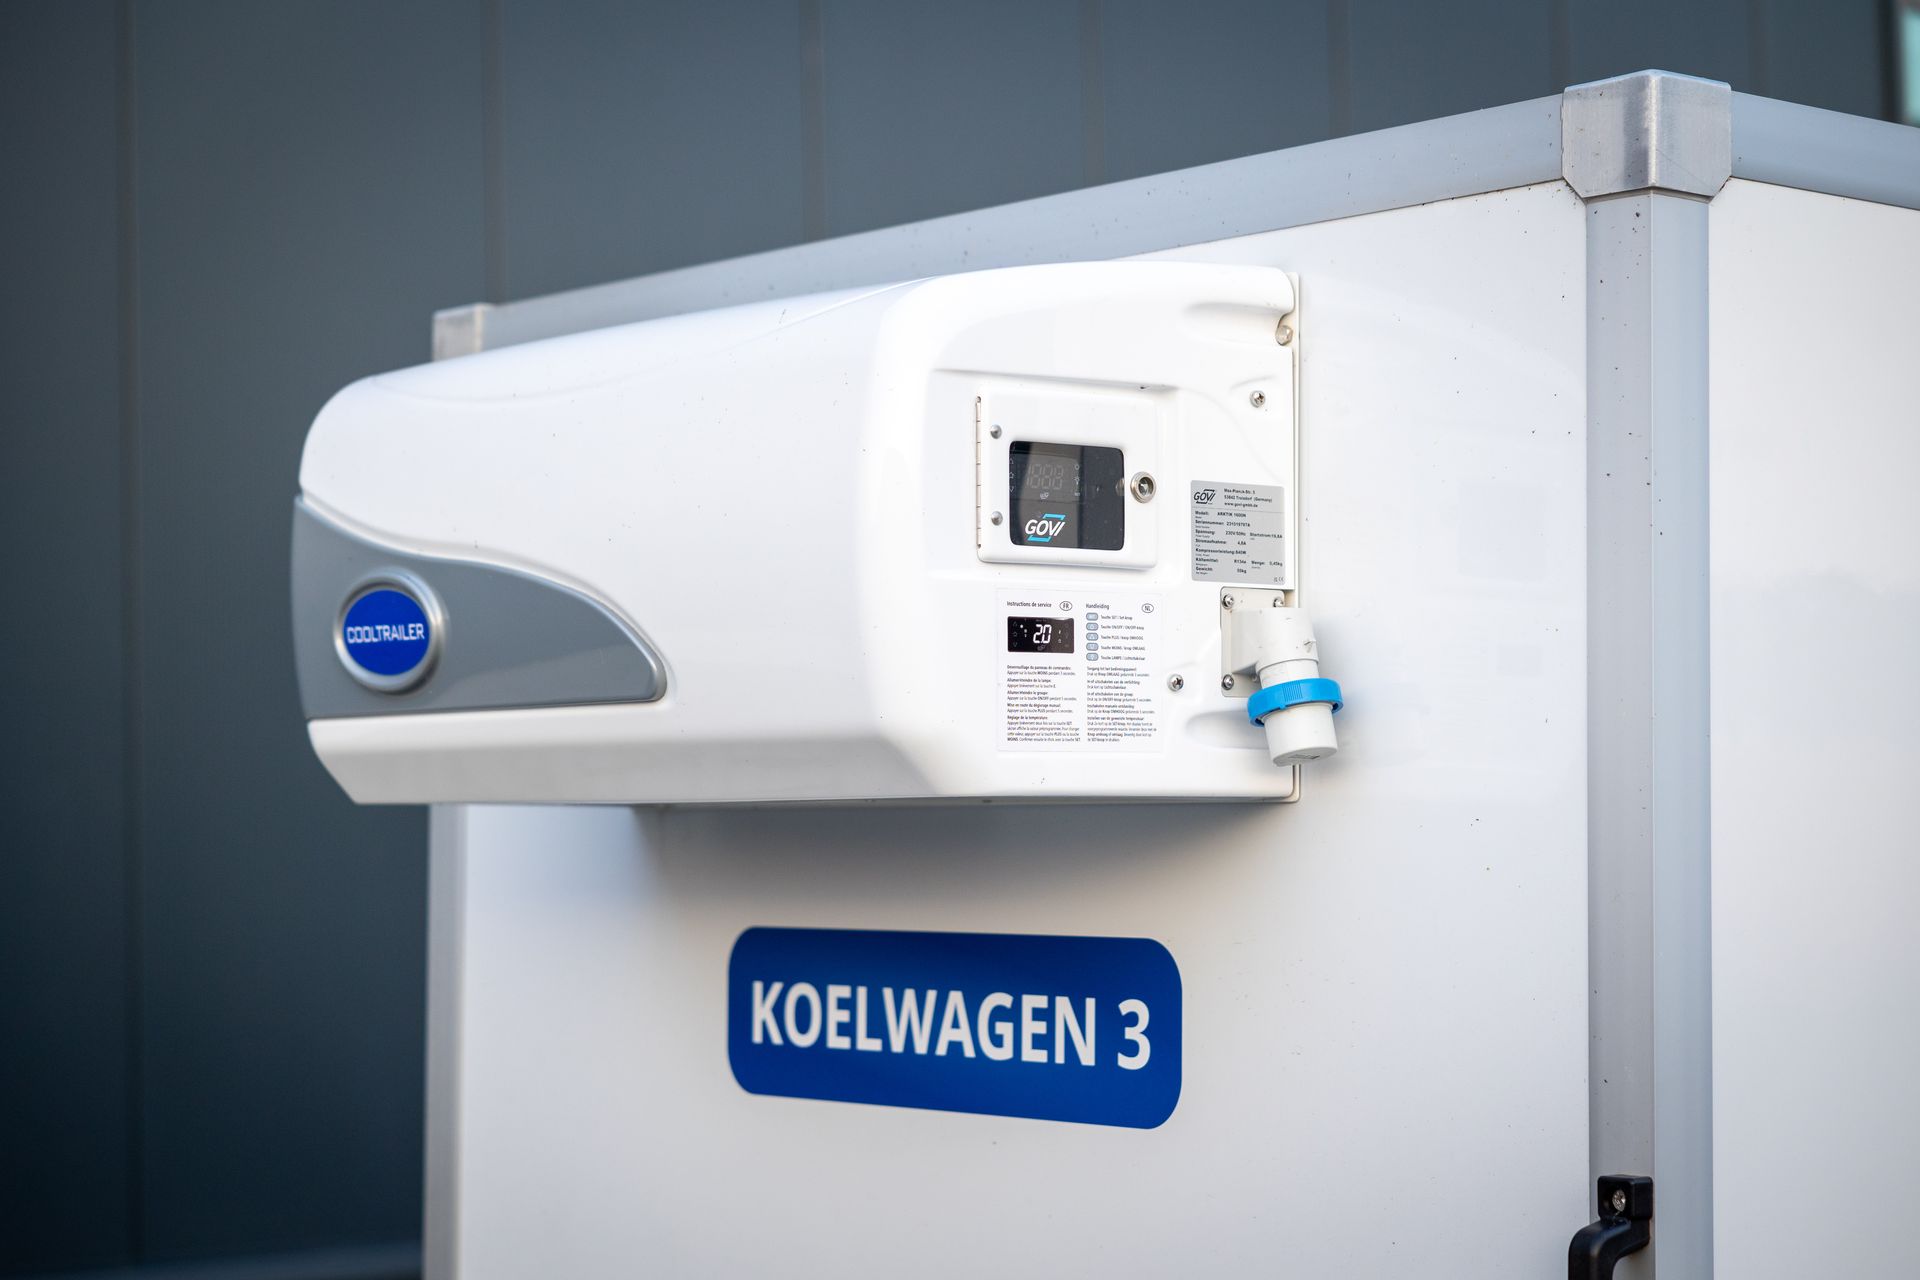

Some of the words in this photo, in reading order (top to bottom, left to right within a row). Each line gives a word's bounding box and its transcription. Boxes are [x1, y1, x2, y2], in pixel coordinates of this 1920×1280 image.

[1194, 492, 1216, 501] GOVI
[1025, 520, 1066, 536] GOVI
[346, 623, 426, 644] COOLTRAILER
[752, 980, 1096, 1066] KOELWAGEN
[1116, 998, 1152, 1070] 3
